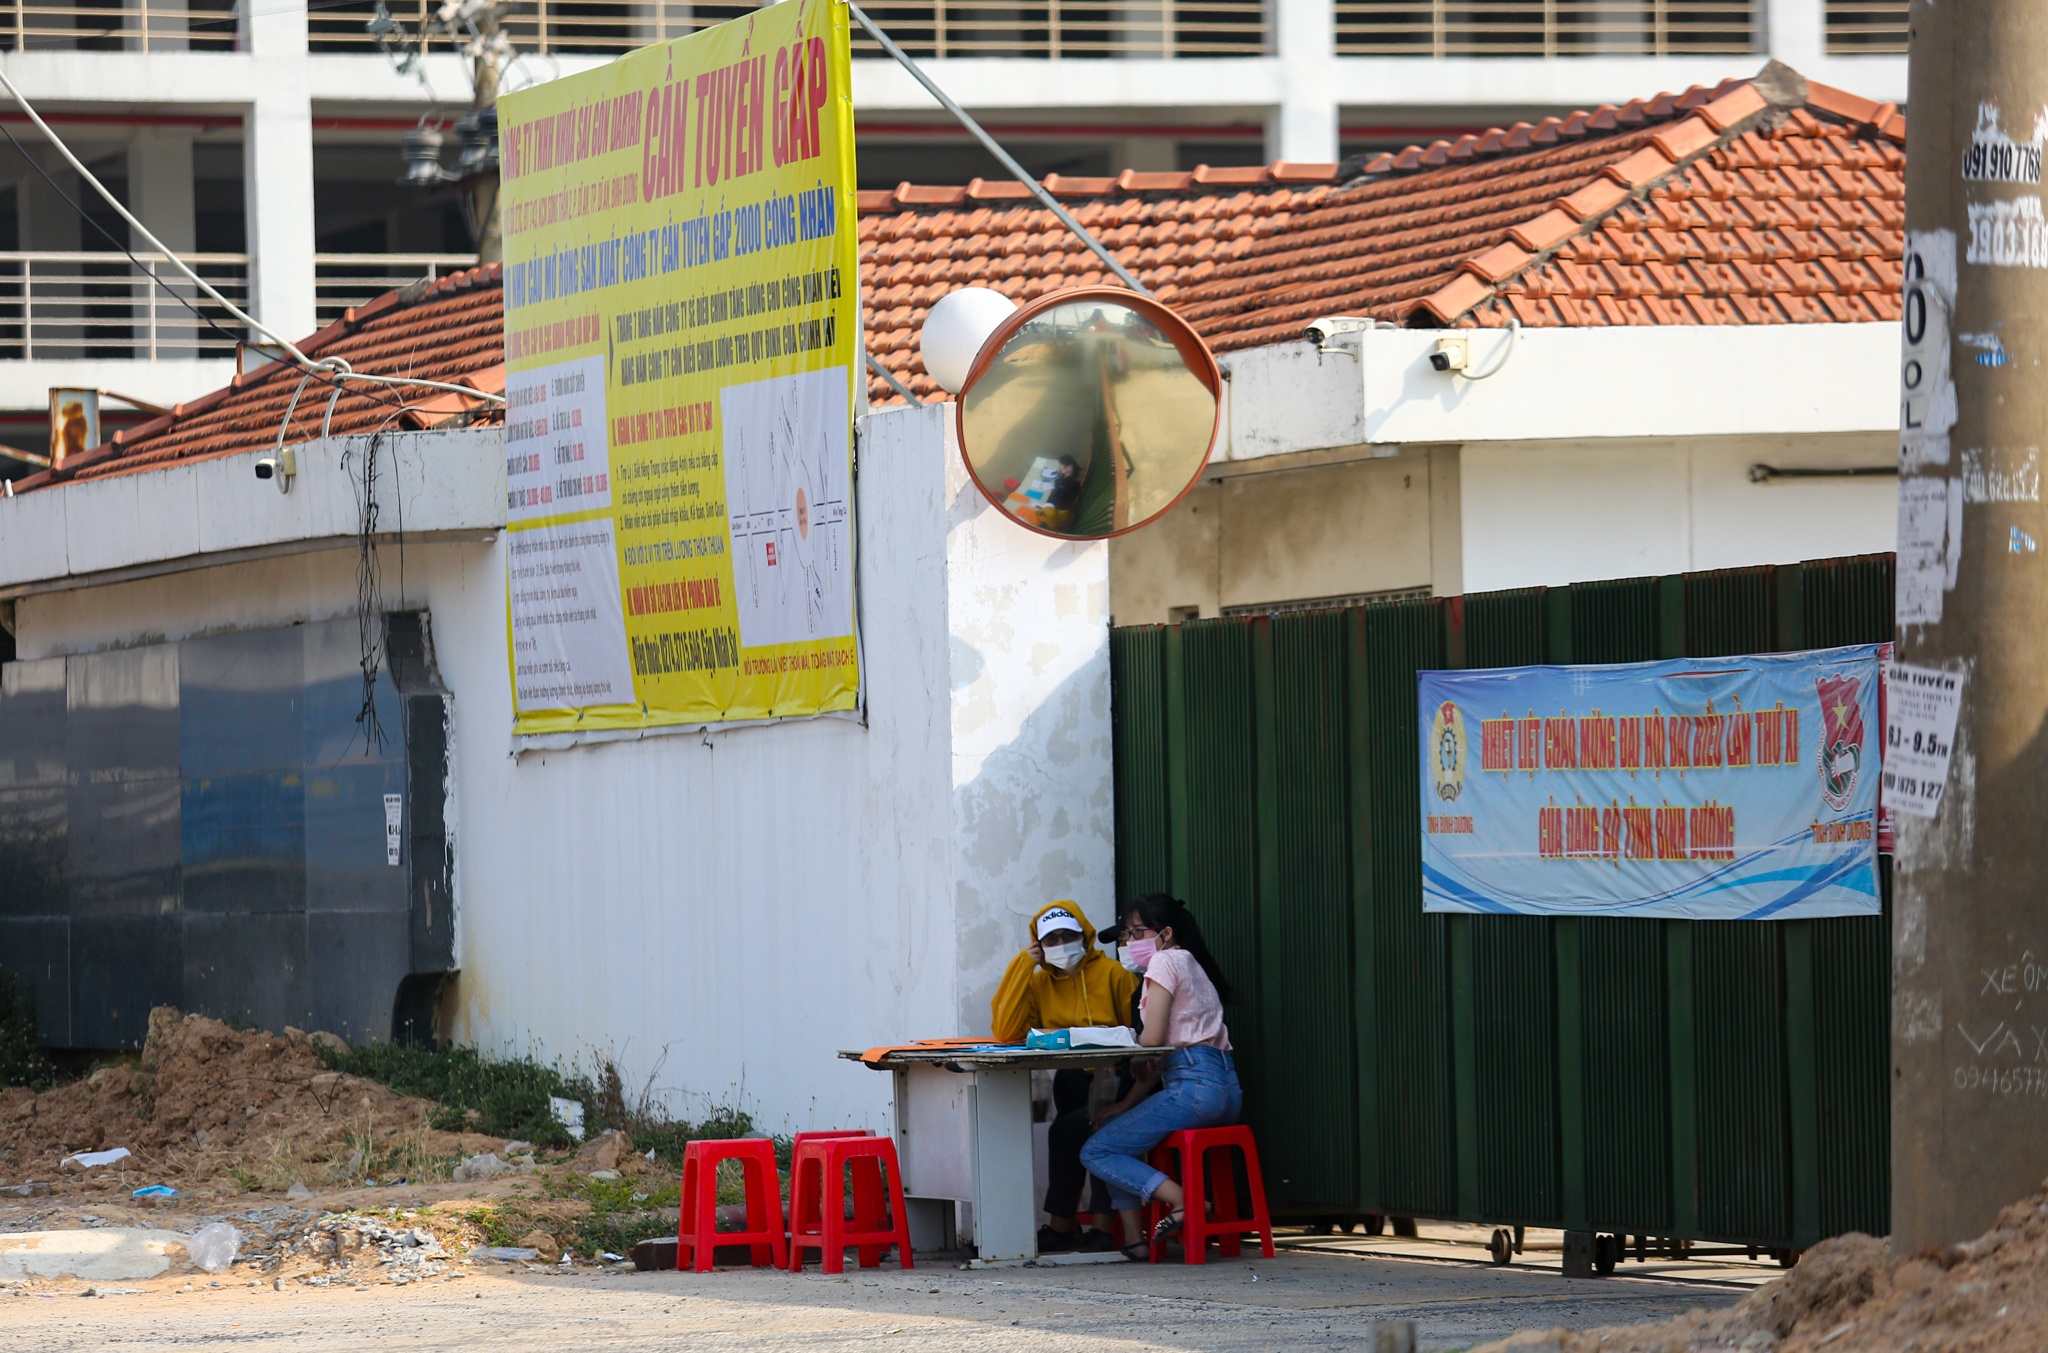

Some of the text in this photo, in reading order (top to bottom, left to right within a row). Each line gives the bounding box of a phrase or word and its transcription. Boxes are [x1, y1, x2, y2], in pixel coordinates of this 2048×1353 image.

[642, 0, 828, 204] CẦN TUYỂN GẤP
[511, 262, 525, 309] NHU
[527, 243, 543, 306] CẦU
[543, 243, 558, 302] MỞ
[557, 244, 578, 304] RỘNG
[580, 234, 597, 293] SẢN
[597, 225, 621, 288] XUẤT
[622, 226, 646, 282] CÔNG
[648, 228, 660, 276] TY
[660, 209, 680, 273] CẦN
[681, 200, 710, 269] TUYỂN
[712, 195, 732, 262] GẤP
[734, 203, 761, 257] 2000
[764, 188, 795, 250] CÔNG
[798, 179, 835, 242] NHÂN
[1481, 709, 1515, 781] NHIỆT
[1518, 708, 1541, 781] LIỆT
[1544, 708, 1576, 771] CHÀO
[1580, 708, 1616, 771] MỪNG
[1619, 716, 1641, 781] ĐẠI
[1644, 705, 1666, 779] HỘI
[1669, 714, 1692, 779] ĐẠI
[1726, 694, 1751, 768] LẦN
[1755, 700, 1783, 766] THỨ
[1785, 707, 1798, 766] XI
[1539, 794, 1734, 870] CỦA ĐẢNG BỘ TỈNH BÌNH DƯƠNG
[1920, 781, 1943, 800] 127
